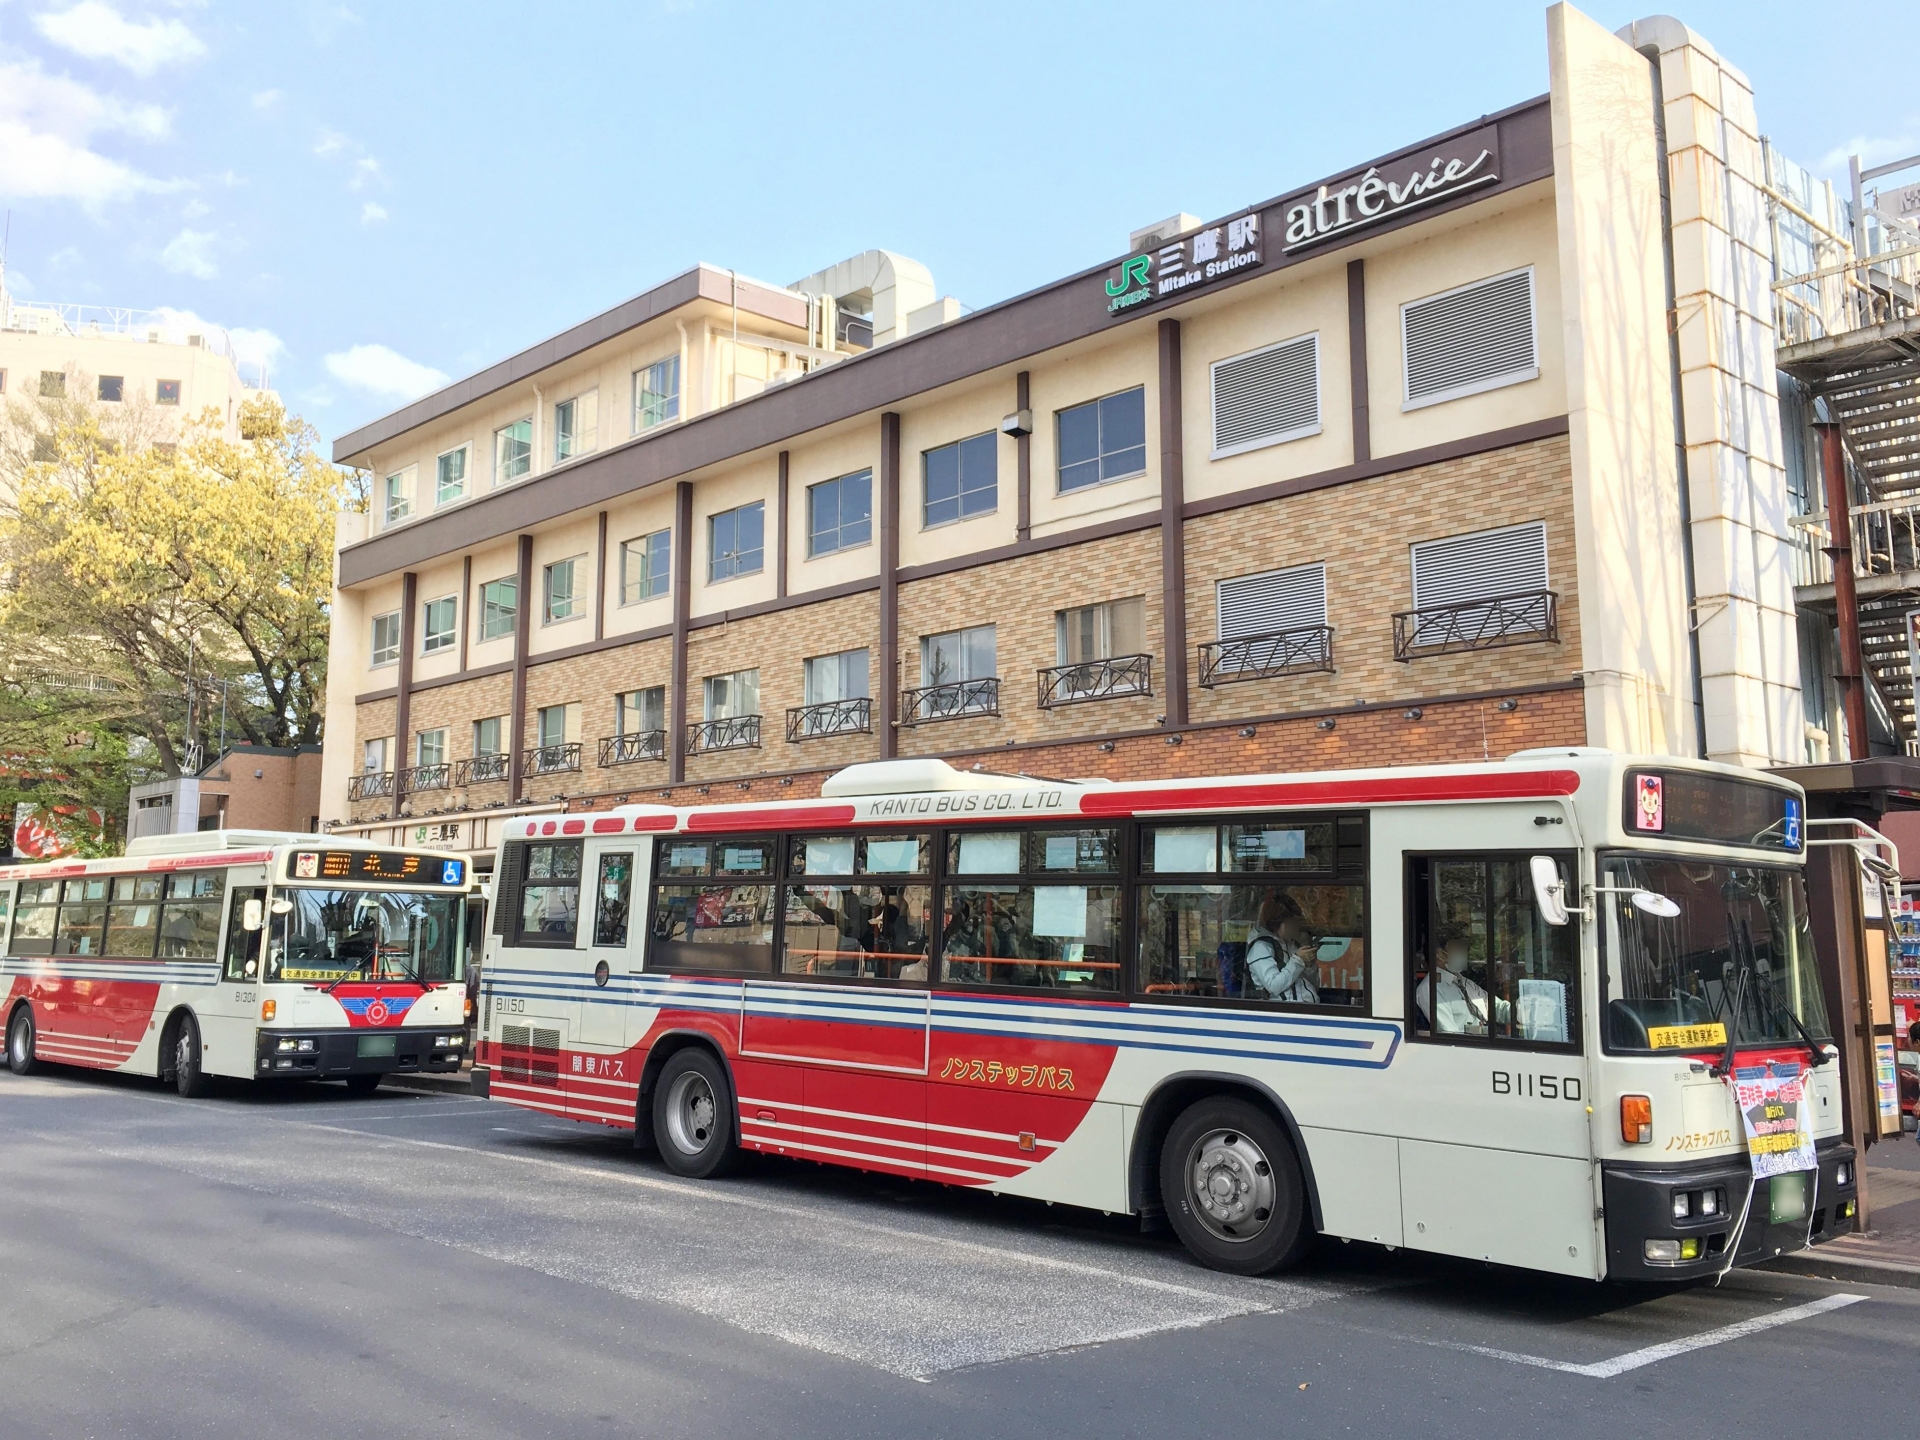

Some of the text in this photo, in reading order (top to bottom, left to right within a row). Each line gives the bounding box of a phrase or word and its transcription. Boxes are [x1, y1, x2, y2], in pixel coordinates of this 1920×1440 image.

[1105, 214, 1258, 296] JR 三鷹駅
[1158, 250, 1256, 295] Mitaka Station
[869, 797, 932, 816] KANTO
[936, 795, 979, 812] BUS
[1022, 791, 1062, 809] LTD.
[415, 823, 460, 842] JR 三鷹駅
[235, 991, 256, 1003] B1304
[496, 997, 525, 1013] B1150
[572, 1055, 624, 1077] 関東バス
[940, 1057, 1075, 1091] ノンステップバス
[1492, 1070, 1582, 1102] B1150
[1665, 1129, 1731, 1151] ノンステップバス
